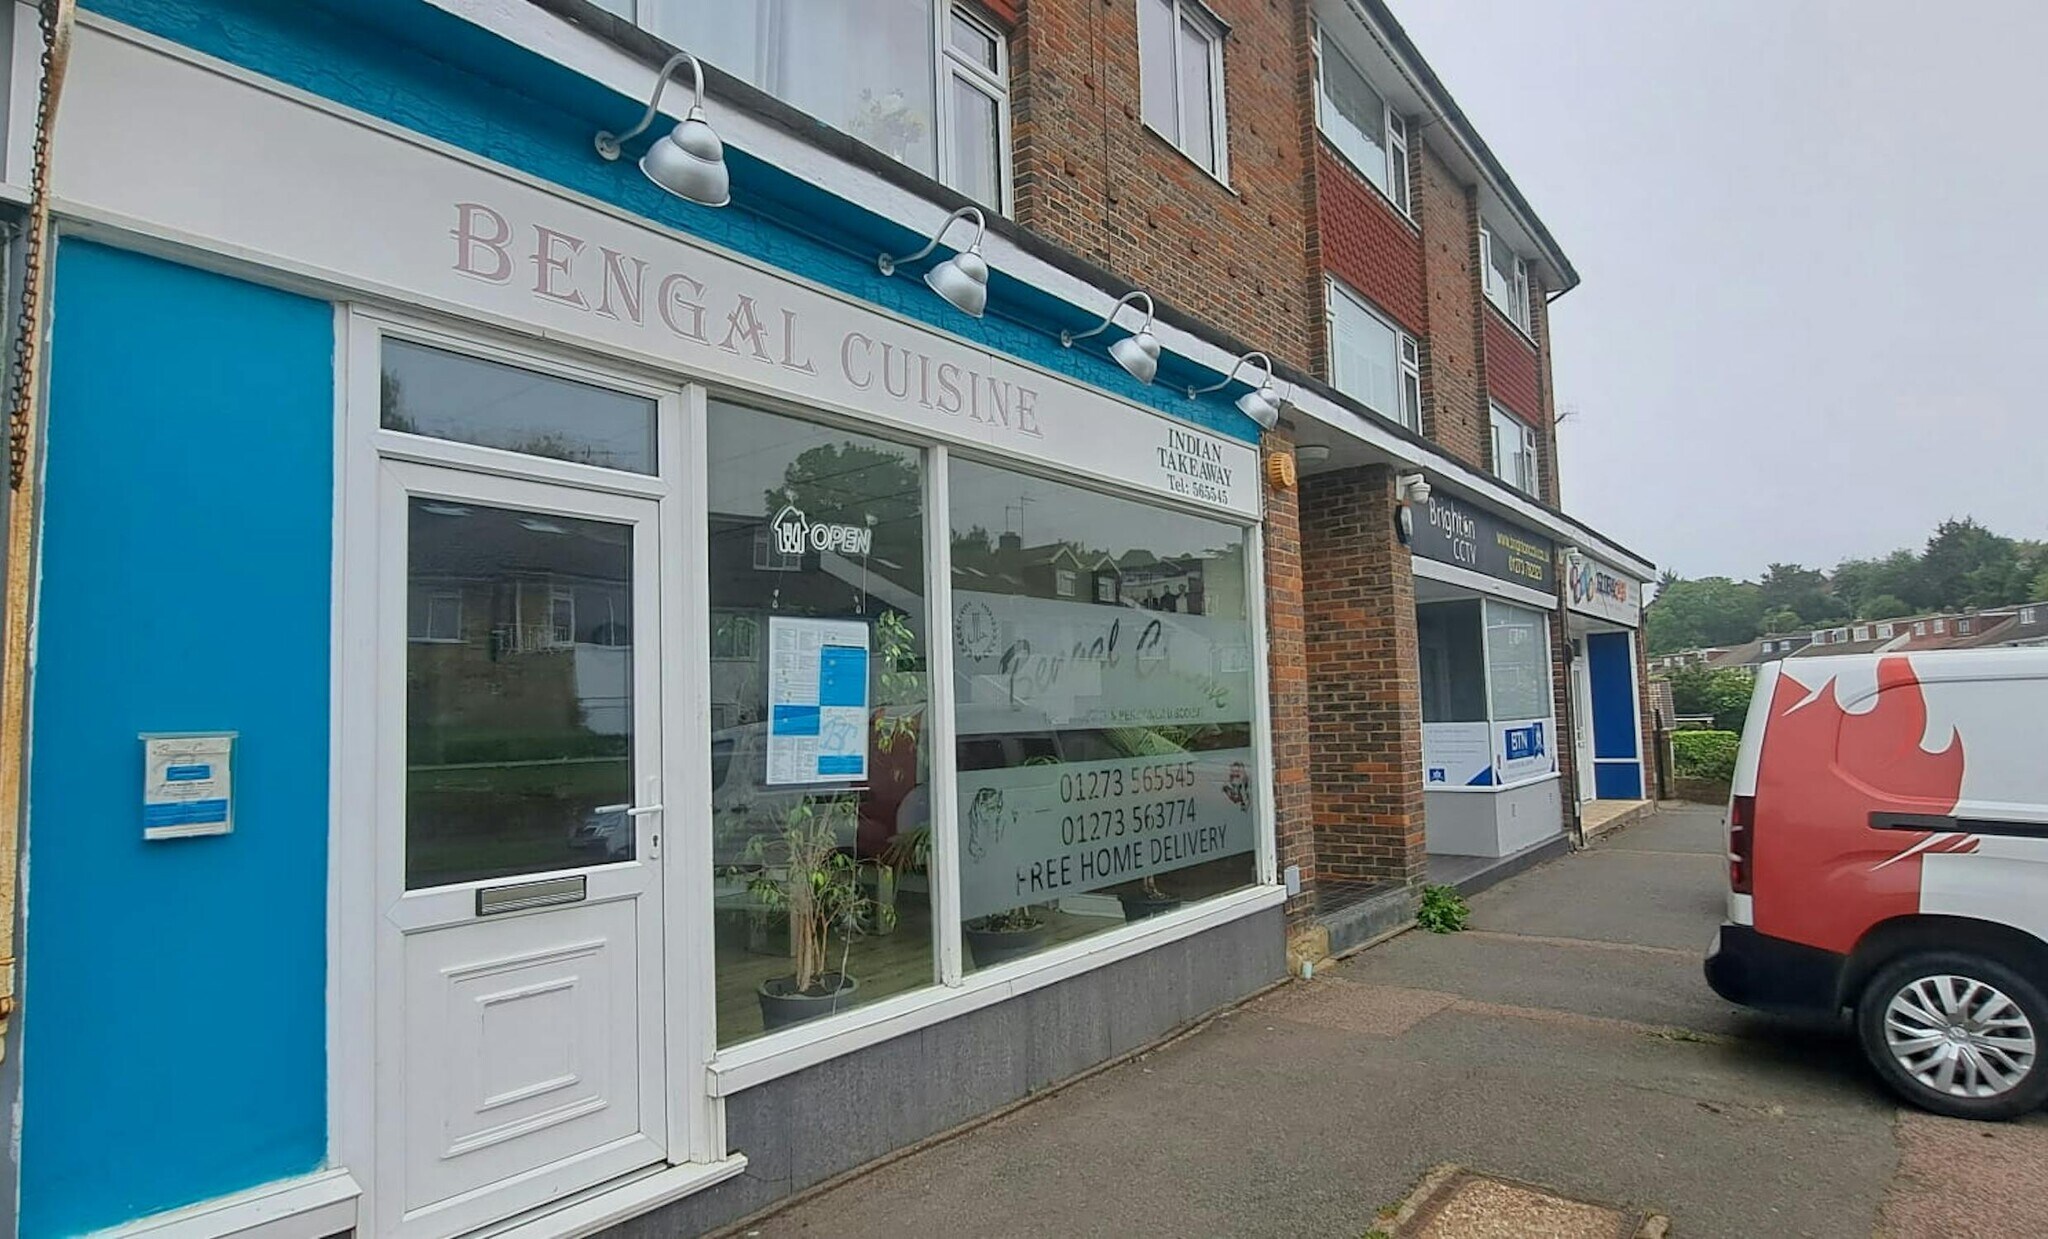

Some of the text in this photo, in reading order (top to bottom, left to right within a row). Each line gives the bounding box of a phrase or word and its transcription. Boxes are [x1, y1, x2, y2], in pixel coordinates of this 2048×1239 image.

[449, 202, 1044, 439] BENGAL CUISINE
[1157, 446, 1232, 487] TAKEAWAY
[1168, 428, 1222, 464] INDIAN
[1167, 473, 1189, 495] Tel:
[809, 523, 872, 555] OPEN
[1453, 538, 1477, 565] CCTV
[1060, 761, 1196, 804] 01273 565545
[1061, 797, 1197, 846] 01273 563774
[1016, 824, 1228, 897] FREE HOME DELIVERY
